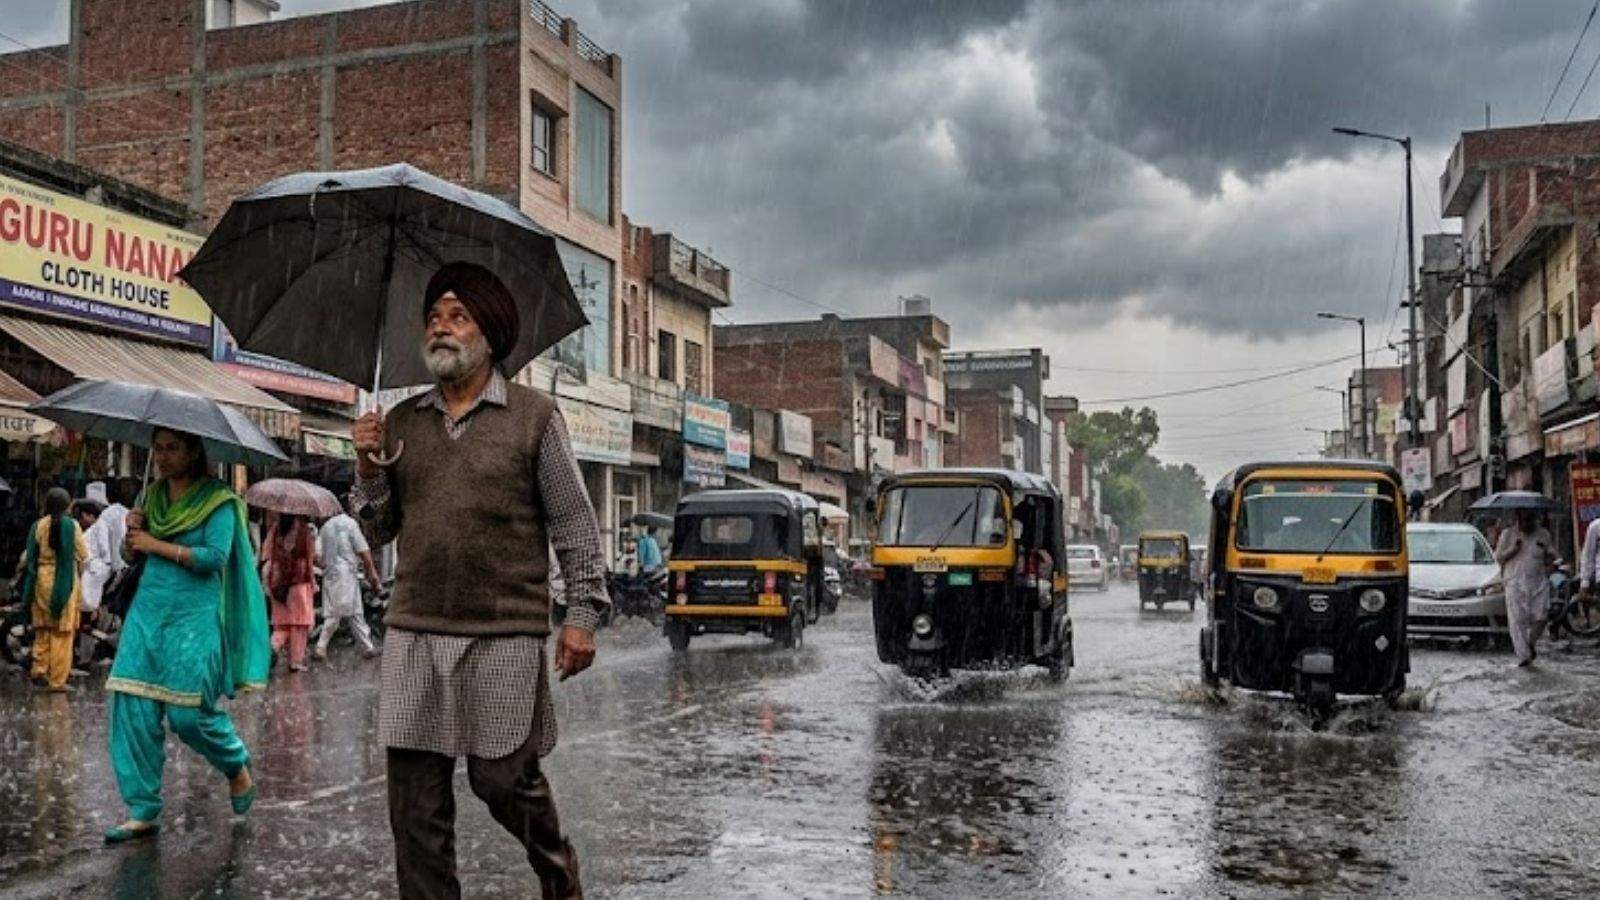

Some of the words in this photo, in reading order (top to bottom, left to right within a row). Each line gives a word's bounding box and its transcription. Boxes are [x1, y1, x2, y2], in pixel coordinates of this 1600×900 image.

[0, 198, 93, 261] GURU
[105, 229, 196, 286] NANA
[42, 260, 104, 294] CLOTH
[112, 277, 169, 309] HOUSE
